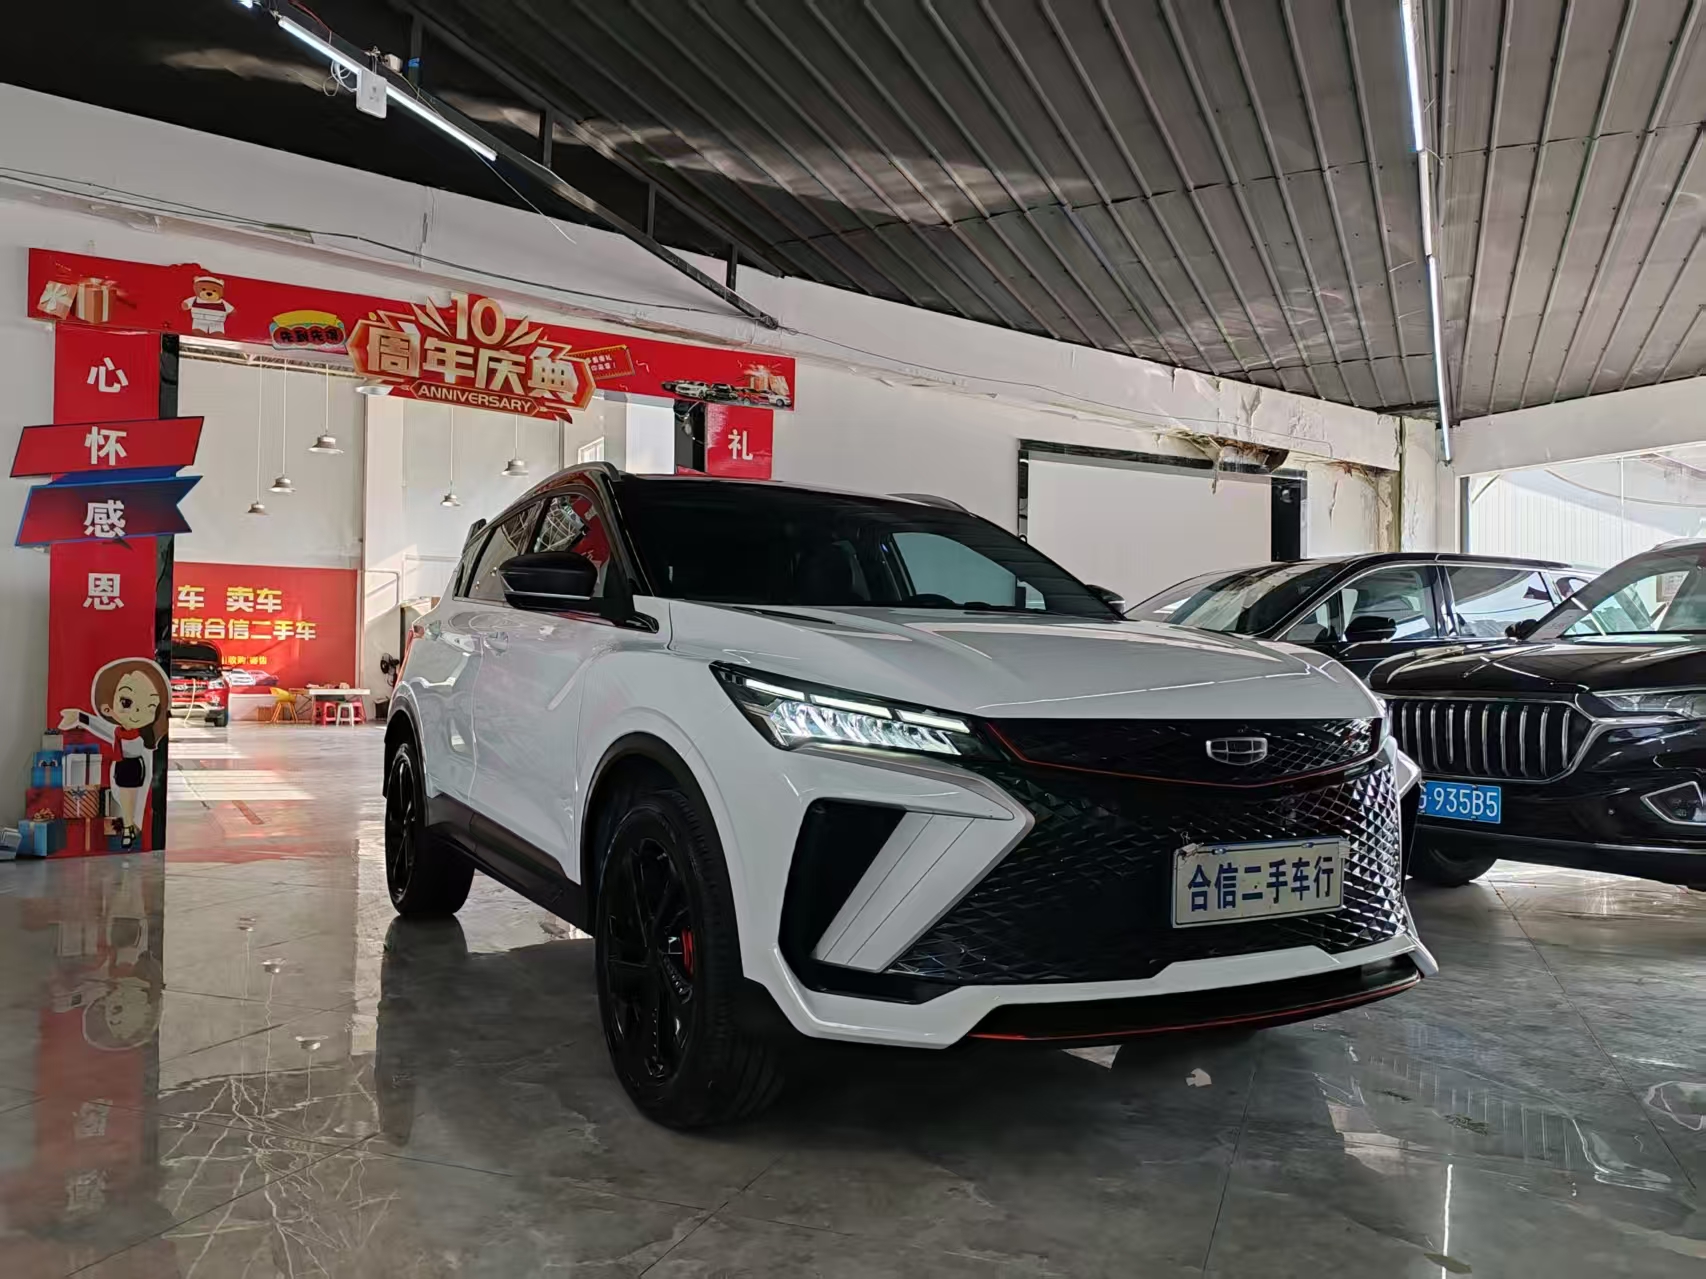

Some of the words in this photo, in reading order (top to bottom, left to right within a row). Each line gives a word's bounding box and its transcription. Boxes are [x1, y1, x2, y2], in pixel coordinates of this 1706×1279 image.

[451, 294, 505, 344] 10
[367, 322, 579, 404] 周年庆典
[417, 384, 532, 413] ANNIVERSARY
[728, 429, 753, 460] 礼
[173, 584, 205, 611] 车
[226, 586, 282, 613] 卖车
[1187, 855, 1335, 912] 合信二手车行
